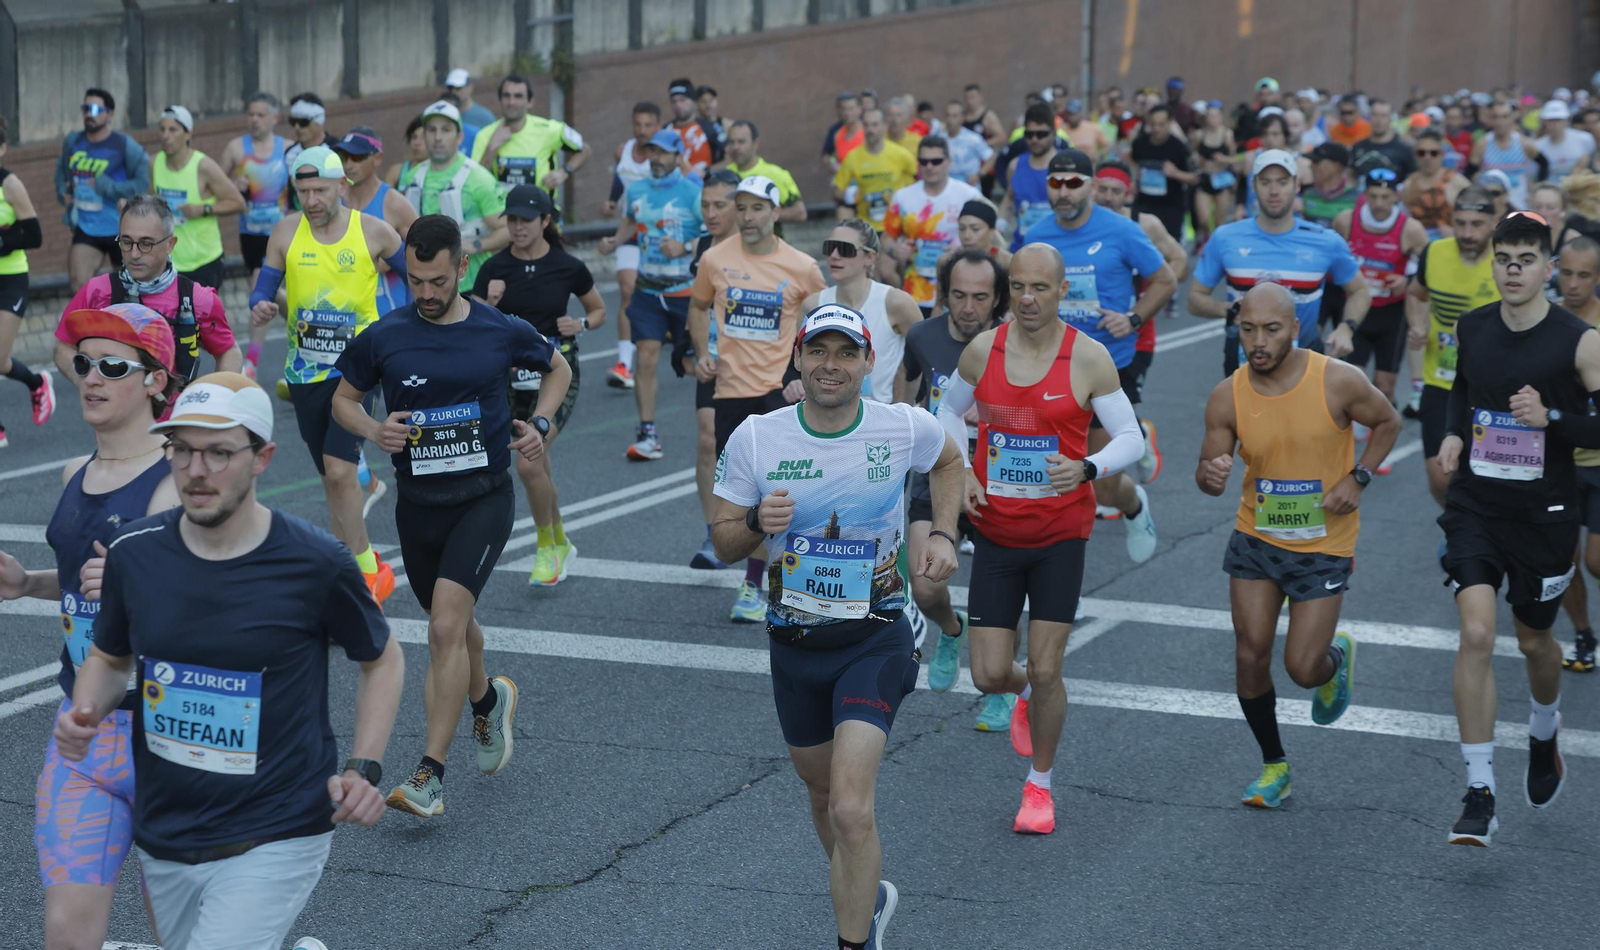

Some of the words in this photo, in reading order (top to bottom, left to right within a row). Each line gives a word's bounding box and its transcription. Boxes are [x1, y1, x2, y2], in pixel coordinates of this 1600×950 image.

[746, 291, 777, 302] ZURICH
[316, 313, 349, 323] ZURICH
[729, 313, 775, 329] ANTONIO
[813, 310, 854, 322] IRONMAN
[316, 328, 334, 338] 3730
[430, 407, 471, 422] ZURICH
[434, 429, 457, 441] 3516
[1496, 435, 1517, 446] 8319
[1009, 438, 1049, 448] ZURICH
[410, 441, 469, 459] MARIANO
[472, 440, 485, 452] G.
[777, 459, 814, 470] RUN
[1010, 457, 1032, 466] 7235
[1484, 451, 1542, 466] AGIRRETXEA
[766, 469, 823, 481] SEVILLA
[867, 465, 891, 480] OTSO
[1000, 468, 1043, 483] PEDRO
[1275, 483, 1314, 492] ZURICH
[1277, 501, 1297, 510] 2017
[1267, 513, 1310, 525] HARRY
[815, 542, 864, 555] ZURICH
[814, 566, 841, 578] 6848
[806, 578, 847, 598] RAUL
[181, 671, 246, 692] ZURICH
[182, 701, 215, 717] 5184
[154, 713, 245, 748] STEFAAN
